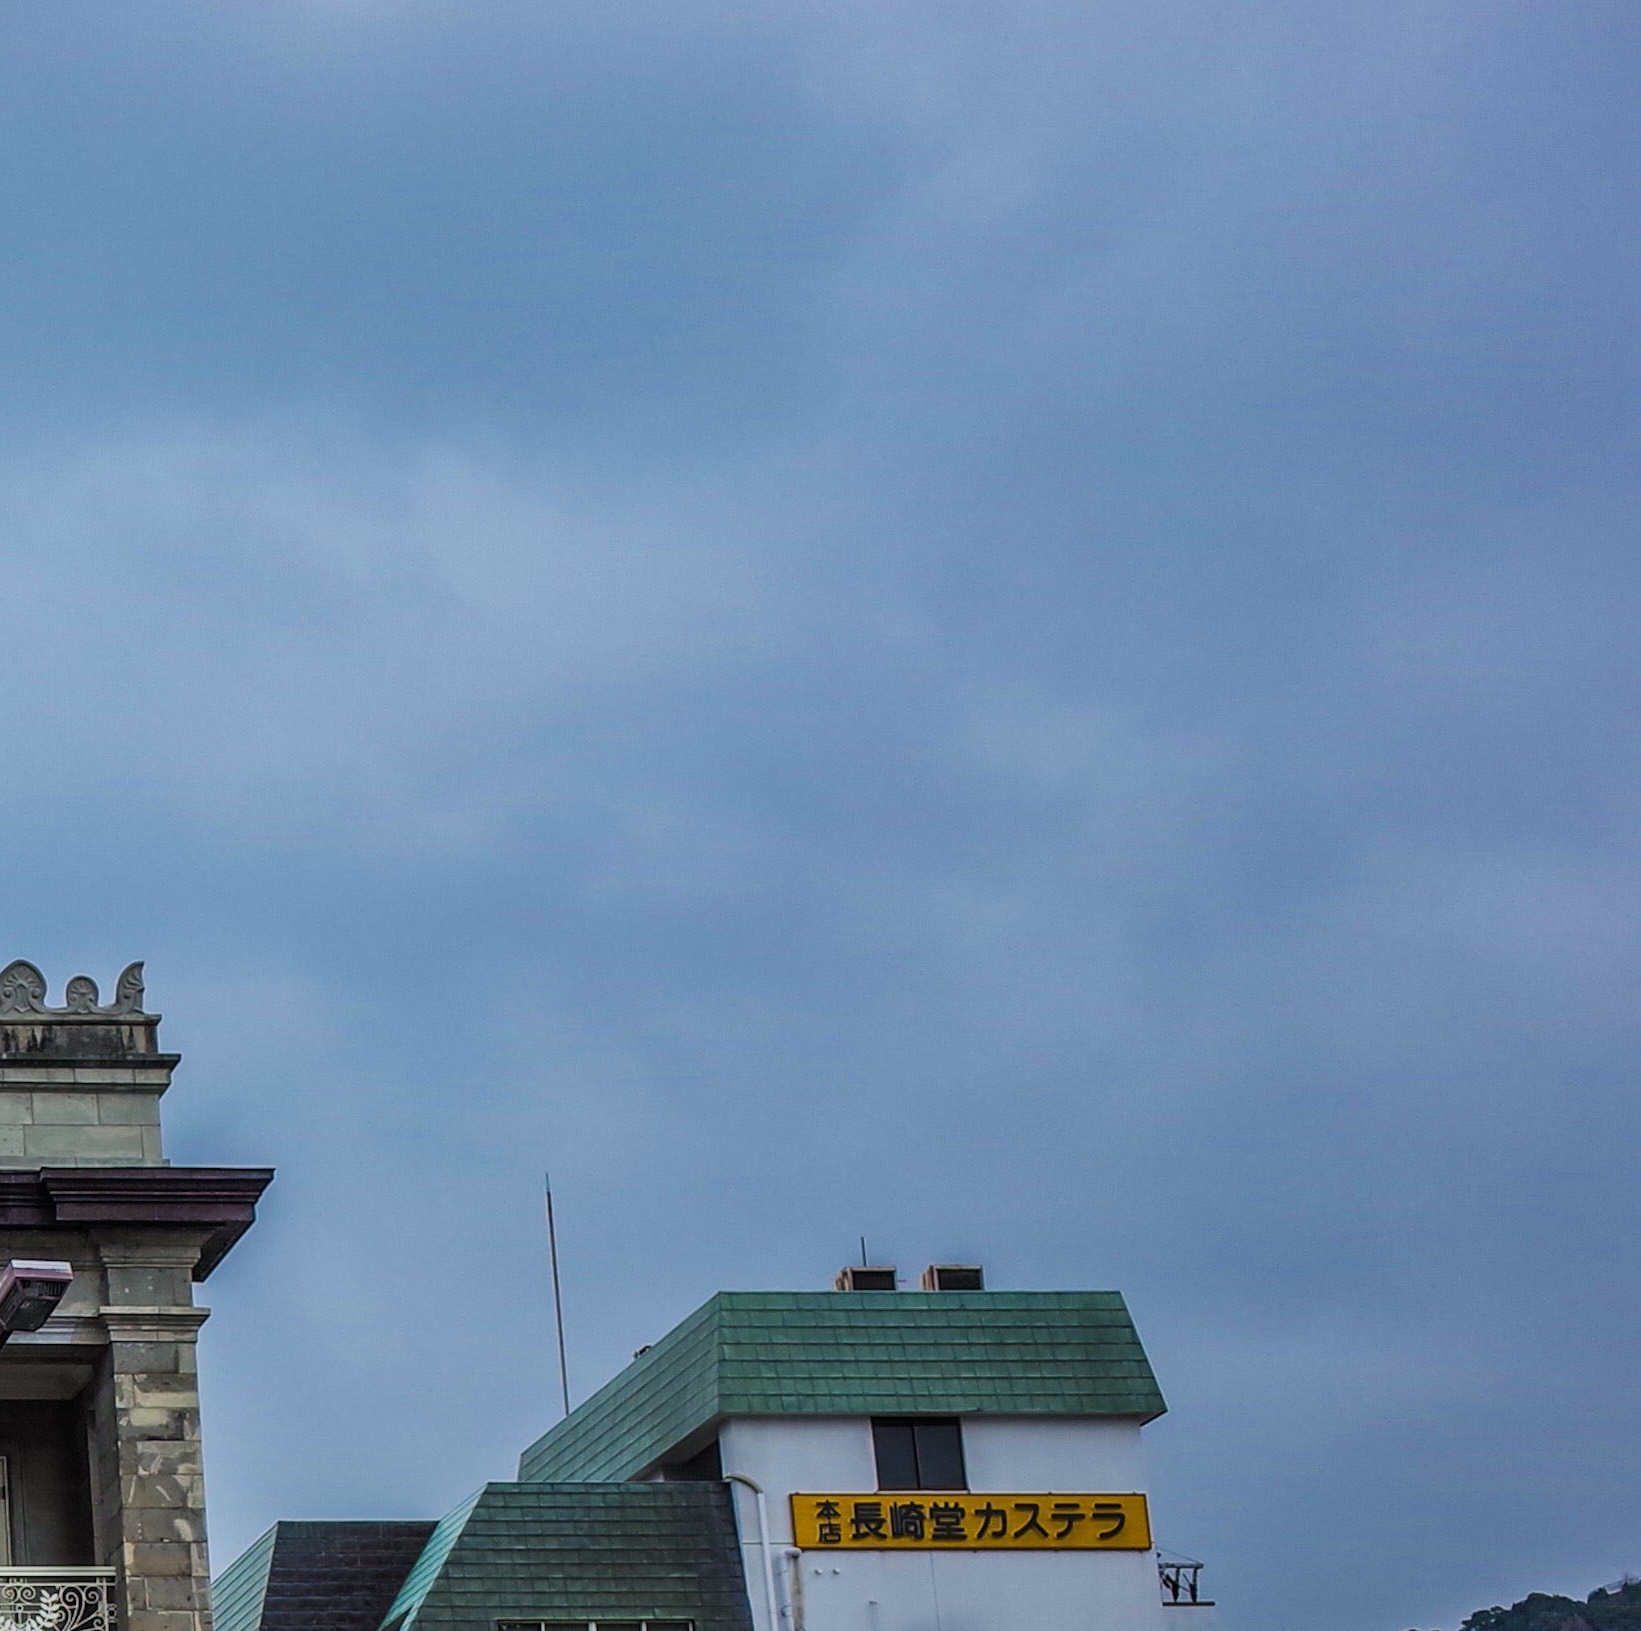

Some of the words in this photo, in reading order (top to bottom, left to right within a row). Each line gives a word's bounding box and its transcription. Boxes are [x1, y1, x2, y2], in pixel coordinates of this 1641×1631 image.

[849, 1500, 1126, 1541] 長崎堂カステラ
